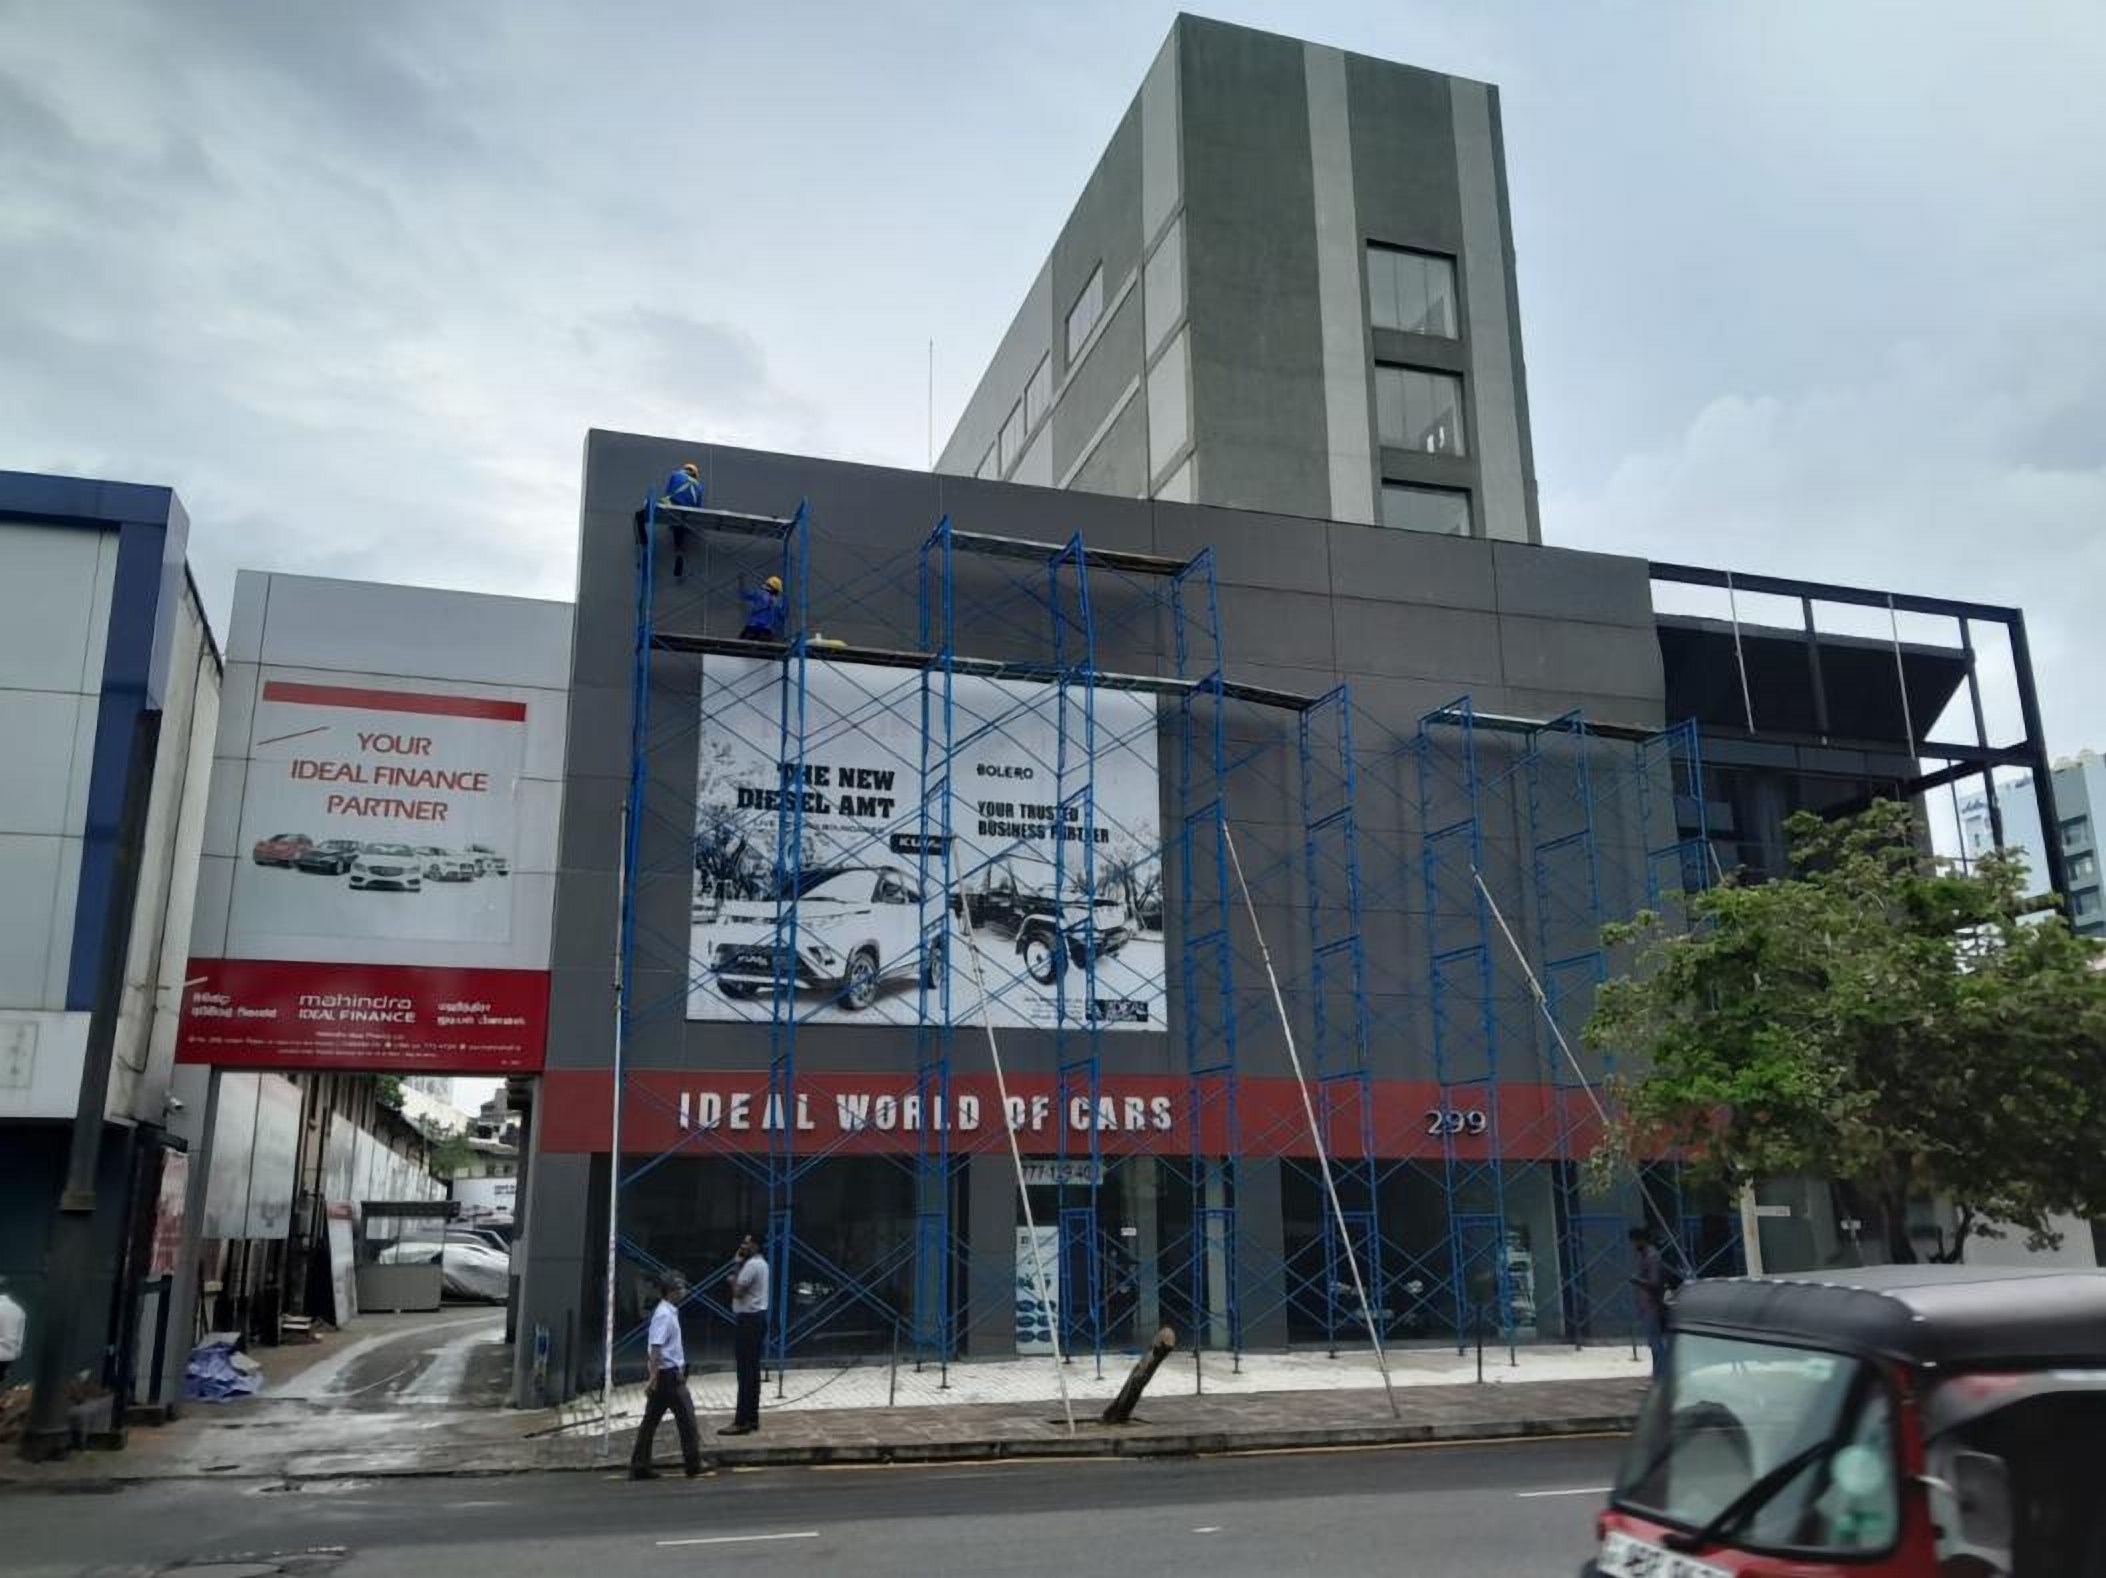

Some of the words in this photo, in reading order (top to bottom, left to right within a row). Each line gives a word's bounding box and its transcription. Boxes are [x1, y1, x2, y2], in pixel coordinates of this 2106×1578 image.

[357, 732, 432, 755] YOUR
[291, 759, 368, 783] IDEAL
[374, 766, 489, 791] FINANCE
[777, 763, 830, 787] THE
[838, 767, 895, 791] NEW
[976, 763, 1034, 780] BOLERO
[326, 794, 448, 821] PARTNER
[737, 787, 830, 814] DIESEL
[838, 795, 895, 818] AMT
[978, 801, 1014, 818] YOUR
[978, 820, 1045, 840] BUSINESS
[1050, 825, 1109, 843] PRTER
[299, 994, 412, 1010] mahindra
[340, 1009, 416, 1023] FINANCE
[680, 1092, 815, 1130] IDEAL
[836, 1094, 980, 1130] WORLD
[1003, 1096, 1050, 1131] OF
[1070, 1096, 1172, 1131] CARS
[1424, 1109, 1487, 1135] 299
